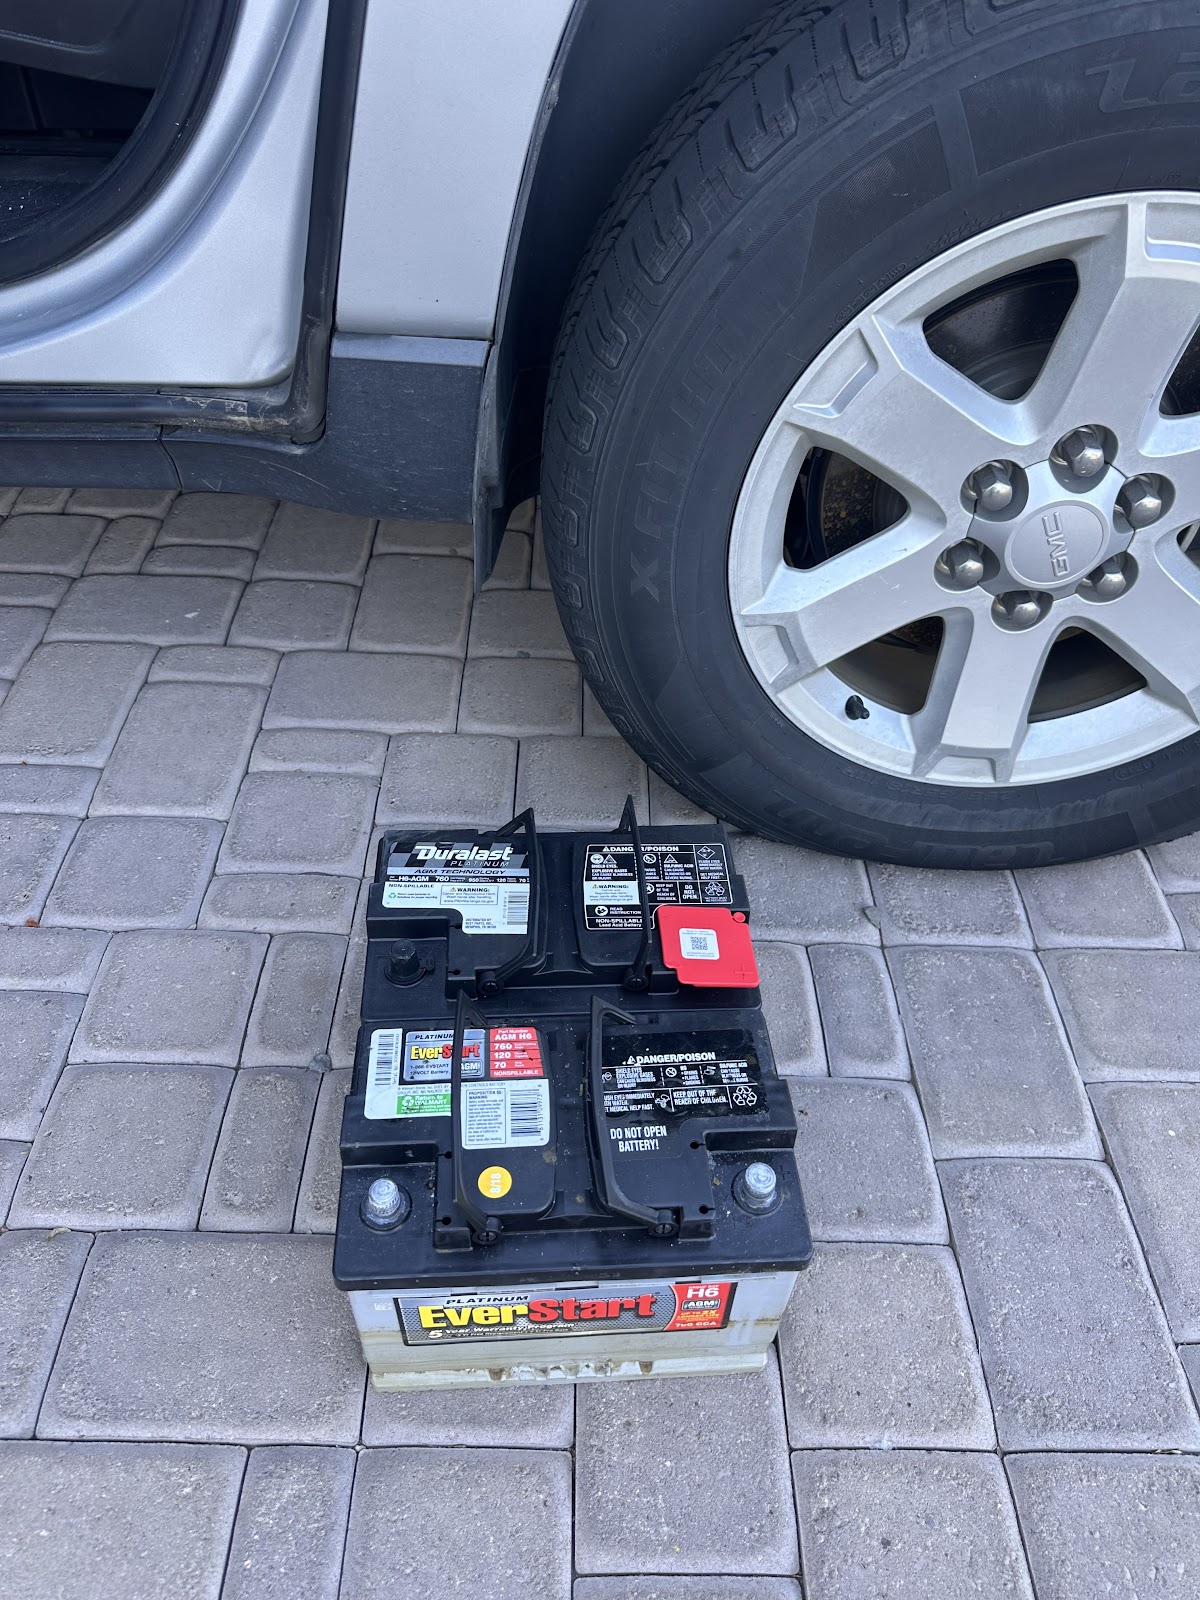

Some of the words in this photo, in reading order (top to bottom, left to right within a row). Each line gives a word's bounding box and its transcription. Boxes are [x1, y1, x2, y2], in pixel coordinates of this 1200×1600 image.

[1042, 512, 1070, 577] GMC
[415, 845, 514, 860] Duralast
[411, 1043, 480, 1060] EverSrt
[636, 1052, 716, 1064] DANGER/POISON
[674, 1098, 692, 1106] REACH
[610, 1128, 623, 1139] DO
[624, 1127, 642, 1139] NOT
[644, 1126, 667, 1137] OPEN
[618, 1139, 659, 1152] BATTERY!
[687, 1288, 719, 1298] H6
[446, 1296, 528, 1304] PLATINUM
[418, 1294, 656, 1328] EverStart
[428, 1330, 443, 1338] 5
